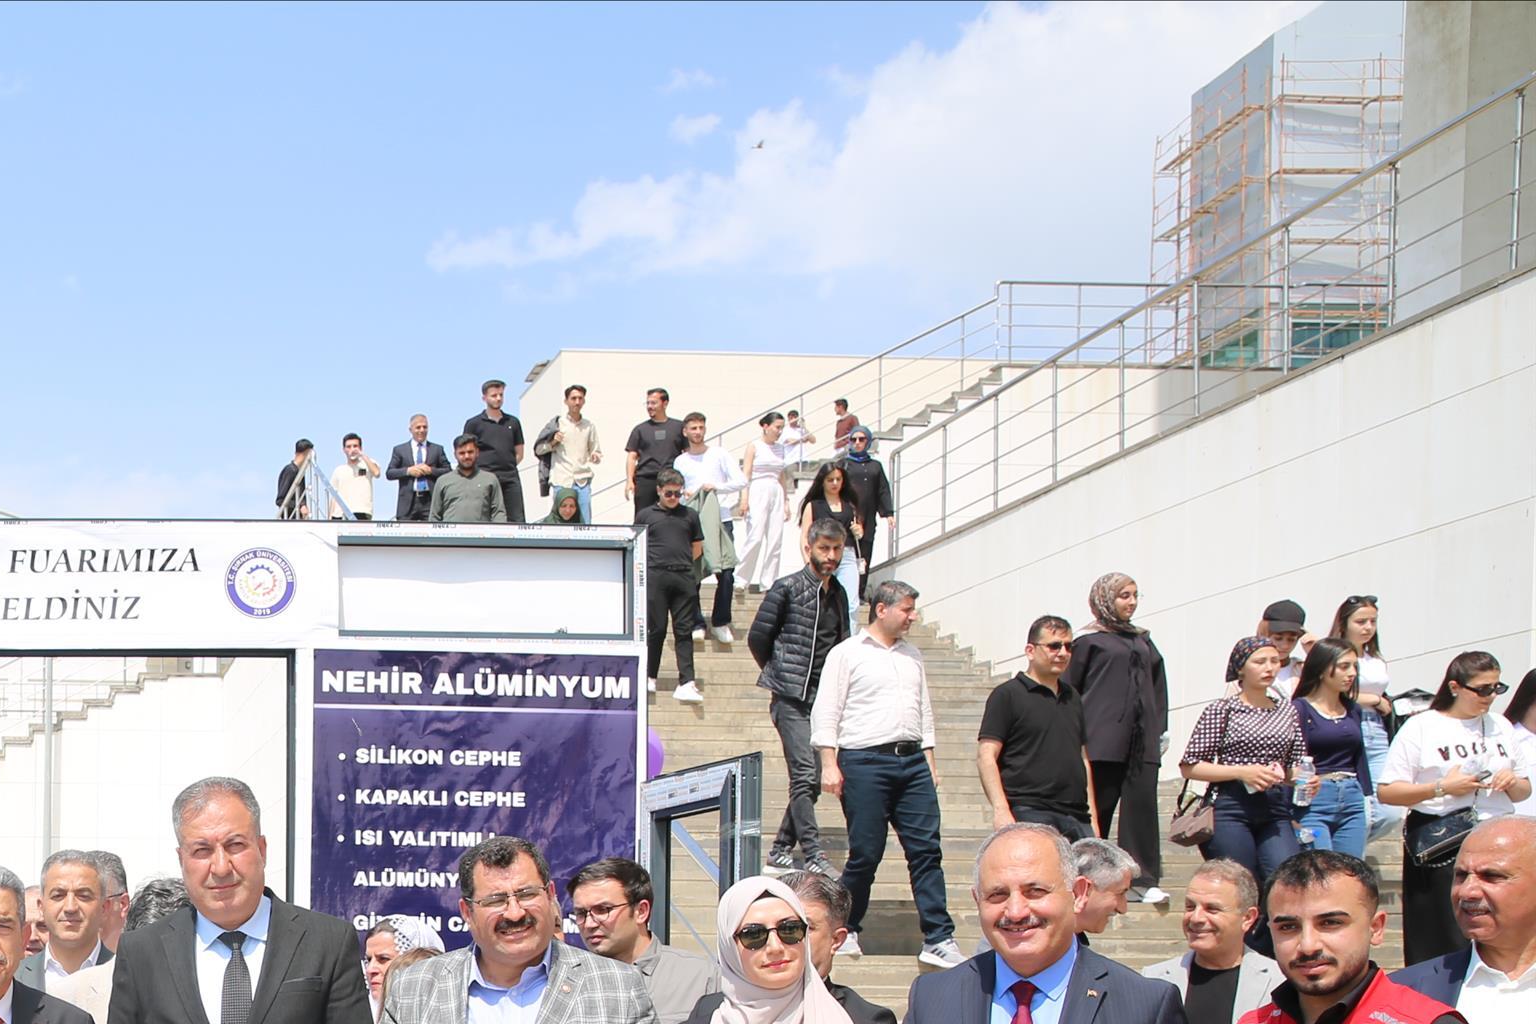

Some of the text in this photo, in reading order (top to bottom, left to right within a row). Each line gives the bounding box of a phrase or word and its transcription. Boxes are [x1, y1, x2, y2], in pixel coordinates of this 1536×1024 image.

[8, 546, 201, 573] FUARIMIZA
[321, 666, 630, 699] NEHİR ALÜMİNYUM
[355, 745, 522, 767] SİLİKON CEPHE
[355, 788, 526, 808] KAPAKLI CEPHE
[355, 829, 383, 846] ISI
